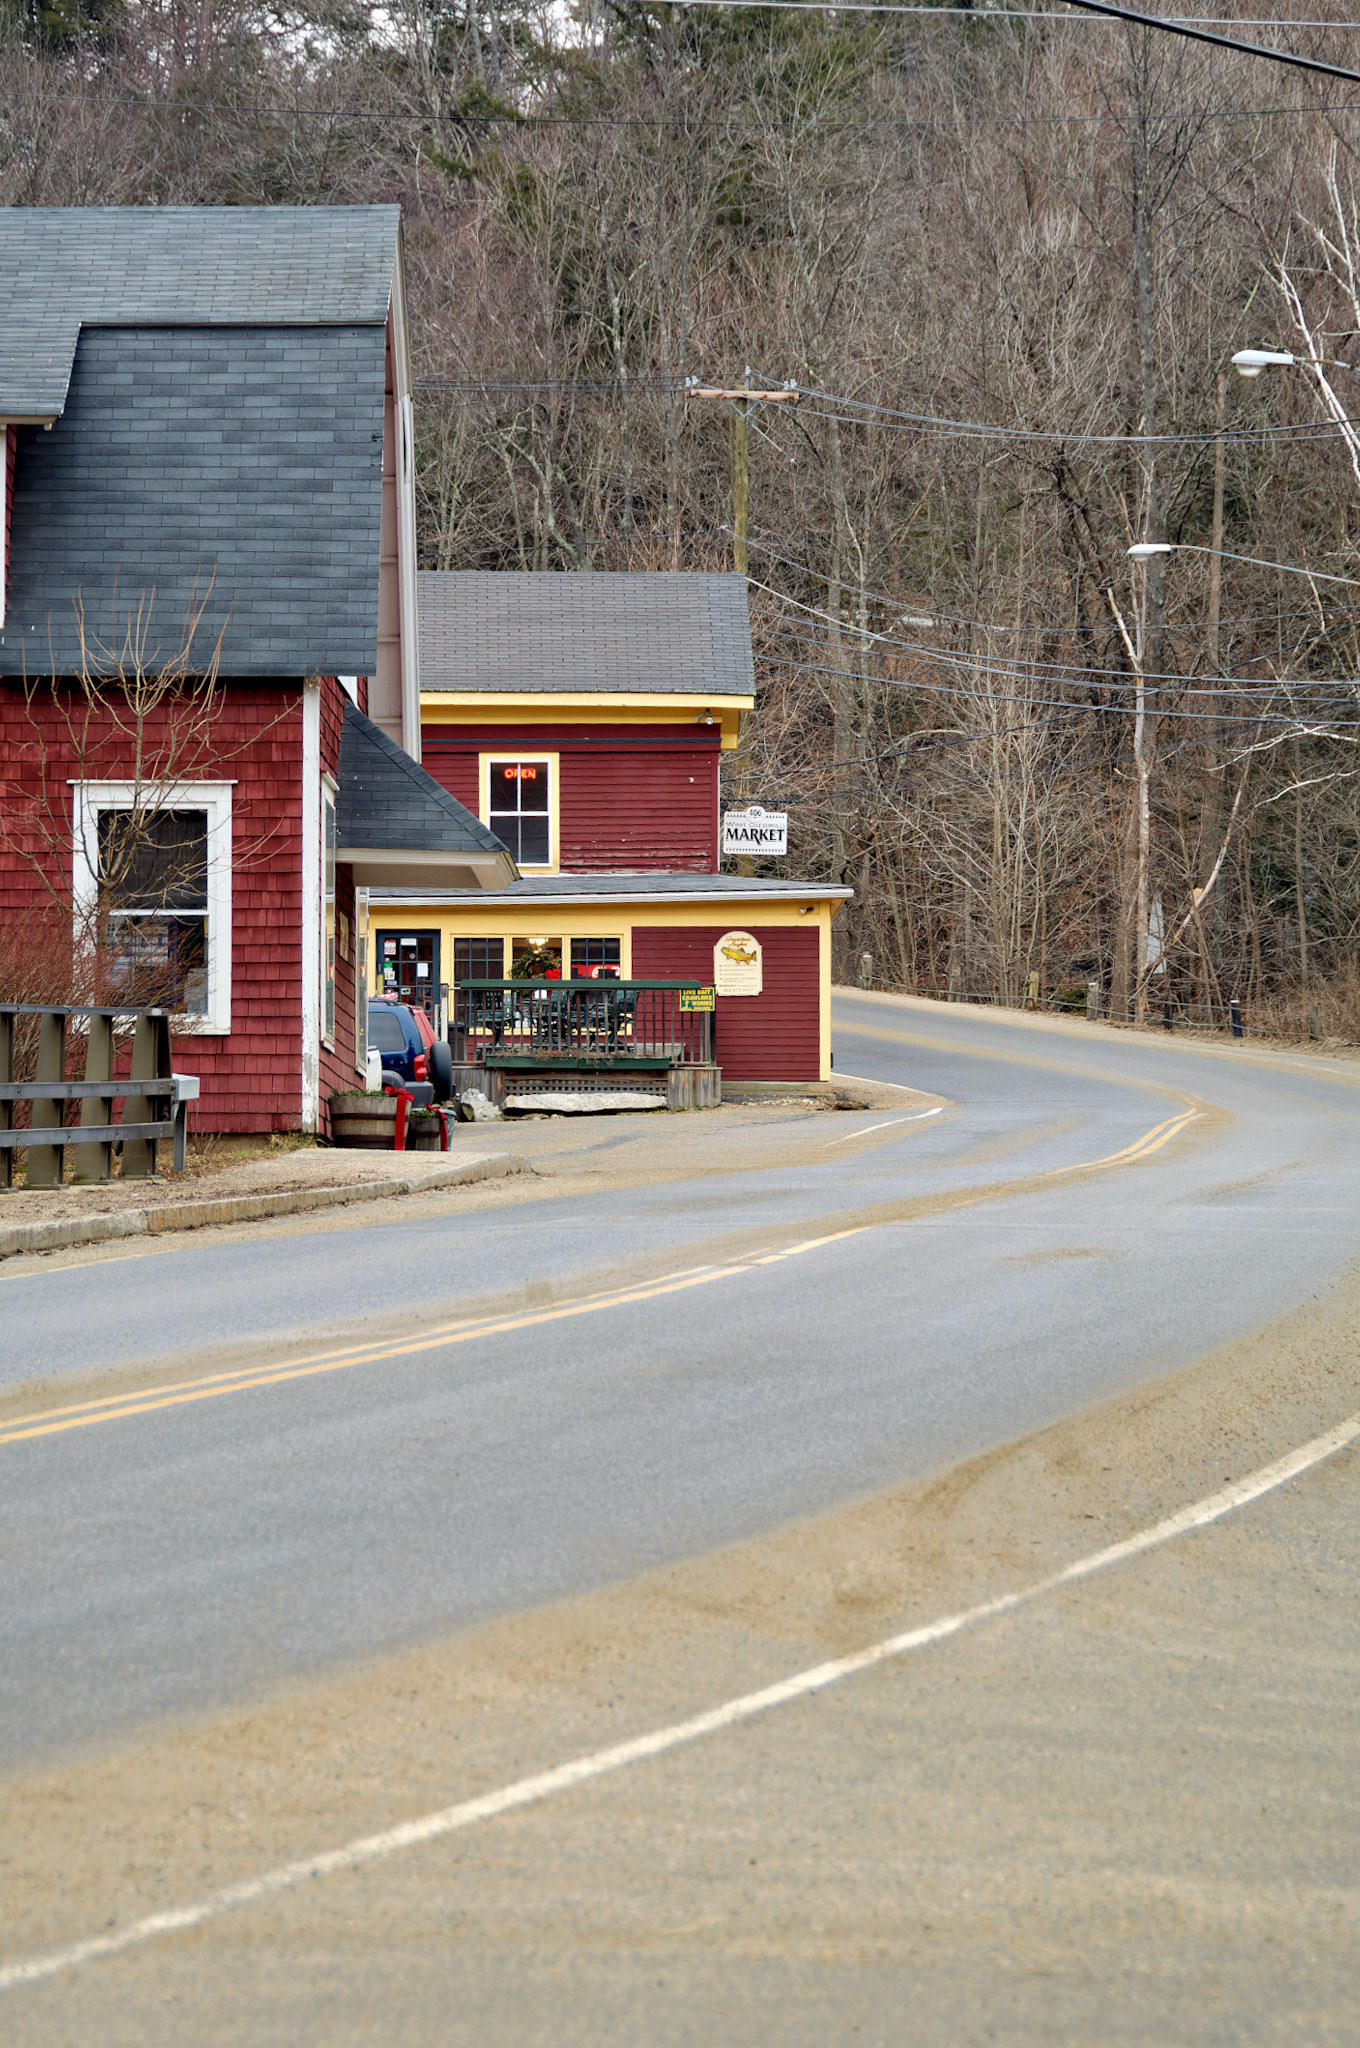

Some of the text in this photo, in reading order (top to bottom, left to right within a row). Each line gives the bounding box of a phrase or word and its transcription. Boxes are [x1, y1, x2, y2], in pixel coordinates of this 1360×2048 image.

[504, 767, 536, 779] OPEN
[750, 809, 762, 817] 406
[725, 828, 785, 845] MARKET
